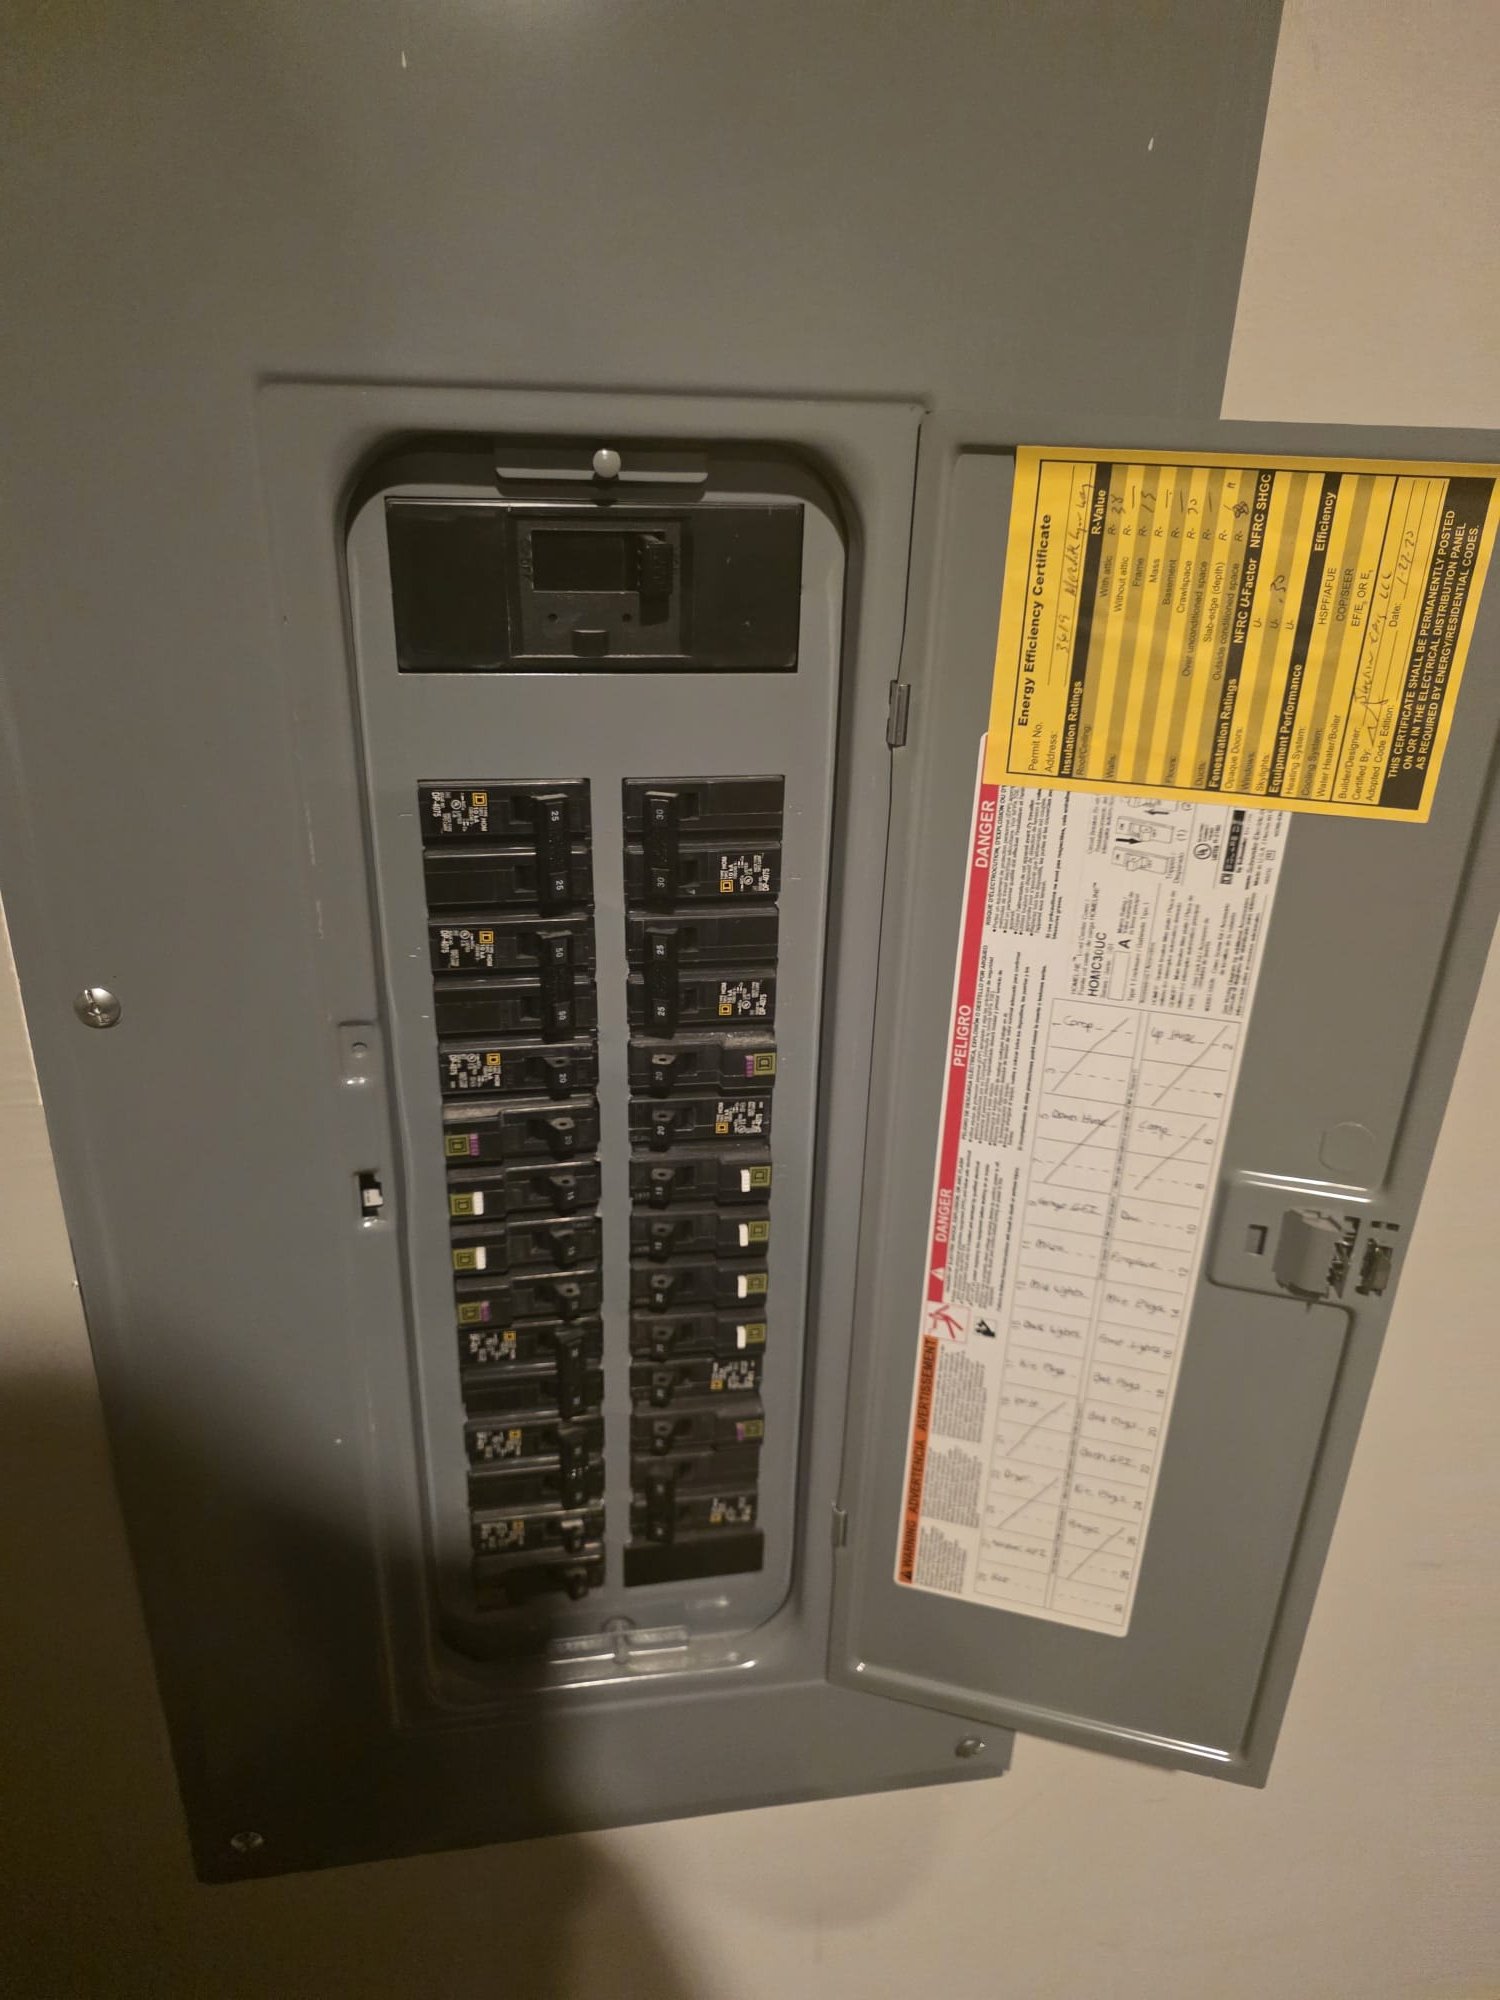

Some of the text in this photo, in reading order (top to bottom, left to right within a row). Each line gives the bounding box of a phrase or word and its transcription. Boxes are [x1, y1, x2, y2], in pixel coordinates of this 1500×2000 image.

[1091, 489, 1106, 534] R-Value
[1107, 523, 1116, 534] R-
[1123, 524, 1131, 535] R-
[1138, 526, 1147, 536] R-
[1154, 526, 1163, 536] R-
[1249, 473, 1271, 547] NFRC SHGC
[1314, 491, 1336, 550] Efficiency
[1170, 527, 1179, 537] R-
[1186, 528, 1195, 538] R-
[1202, 529, 1211, 539] R-
[1218, 529, 1227, 540] R-
[1234, 530, 1243, 541] R-
[1099, 555, 1112, 597] With attic
[1113, 556, 1129, 611] Without attic
[1132, 557, 1144, 586] Frame
[1148, 558, 1159, 582] Mass
[1161, 559, 1176, 605] Basement
[1176, 560, 1192, 613] Crawlspace
[1357, 582, 1367, 597] OR
[1203, 561, 1225, 641] Slab-edge (depth)
[1233, 558, 1257, 642] NFRC U-Factor
[1317, 567, 1337, 624] HSPF/AFUE
[1335, 567, 1354, 621] COP/SEER
[1389, 602, 1402, 626] Date:
[1017, 514, 1051, 726] Energy Efficiency Certificate
[1182, 561, 1209, 676] Over unconditioned space
[1212, 563, 1241, 680] Outside conditioned space
[1253, 617, 1262, 627] U-
[1269, 618, 1278, 628] U-
[1285, 619, 1295, 629] U-
[1387, 510, 1455, 778] THIS CERTIFICATE SHALL BE PERMANENTLY POSTED
[1402, 522, 1466, 769] ON OR IN THE ELECTRICAL DISTRIBUTION PANEL
[1415, 524, 1480, 769] AS REQUIRED BY ENERGY/RESIDENTIAL CODES.
[1028, 721, 1042, 770] Permit No.
[1061, 681, 1083, 773] Insulation Ratings
[1208, 678, 1238, 787] Fenestration Ratings
[1268, 736, 1290, 792] Equipment
[1280, 664, 1302, 733] Performance
[1044, 730, 1057, 772] Address:
[1224, 726, 1242, 788] Opaque Doors:
[1240, 751, 1254, 790] Windows:
[1256, 753, 1271, 791] Skylights:
[1285, 726, 1306, 794] Heating System:
[1301, 727, 1323, 795] Cooling System:
[1316, 714, 1341, 796] Water Heater/Boiler
[1337, 727, 1362, 798] Builder/Designer:
[1365, 704, 1394, 801] Adopted Code Edition:
[1351, 765, 1367, 800] Certified
[432, 792, 441, 817] DP-4075
[480, 818, 488, 831] HOM
[552, 811, 559, 821] 25
[656, 809, 664, 820] 30
[974, 799, 995, 868] DANGER
[556, 880, 564, 890] 25
[657, 877, 665, 888] 30
[556, 948, 563, 958] 50
[656, 945, 665, 955] 25
[1117, 938, 1130, 948] A
[657, 1006, 666, 1016] 25
[953, 1004, 971, 1066] PELIGRO
[559, 1073, 567, 1083] 20
[935, 1188, 951, 1242] DANGER
[1187, 1224, 1196, 1234] 10
[914, 1338, 936, 1431] AVERTISSEMENT
[908, 1438, 925, 1512] ADVERTENCIA
[902, 1520, 916, 1567] WARNING
